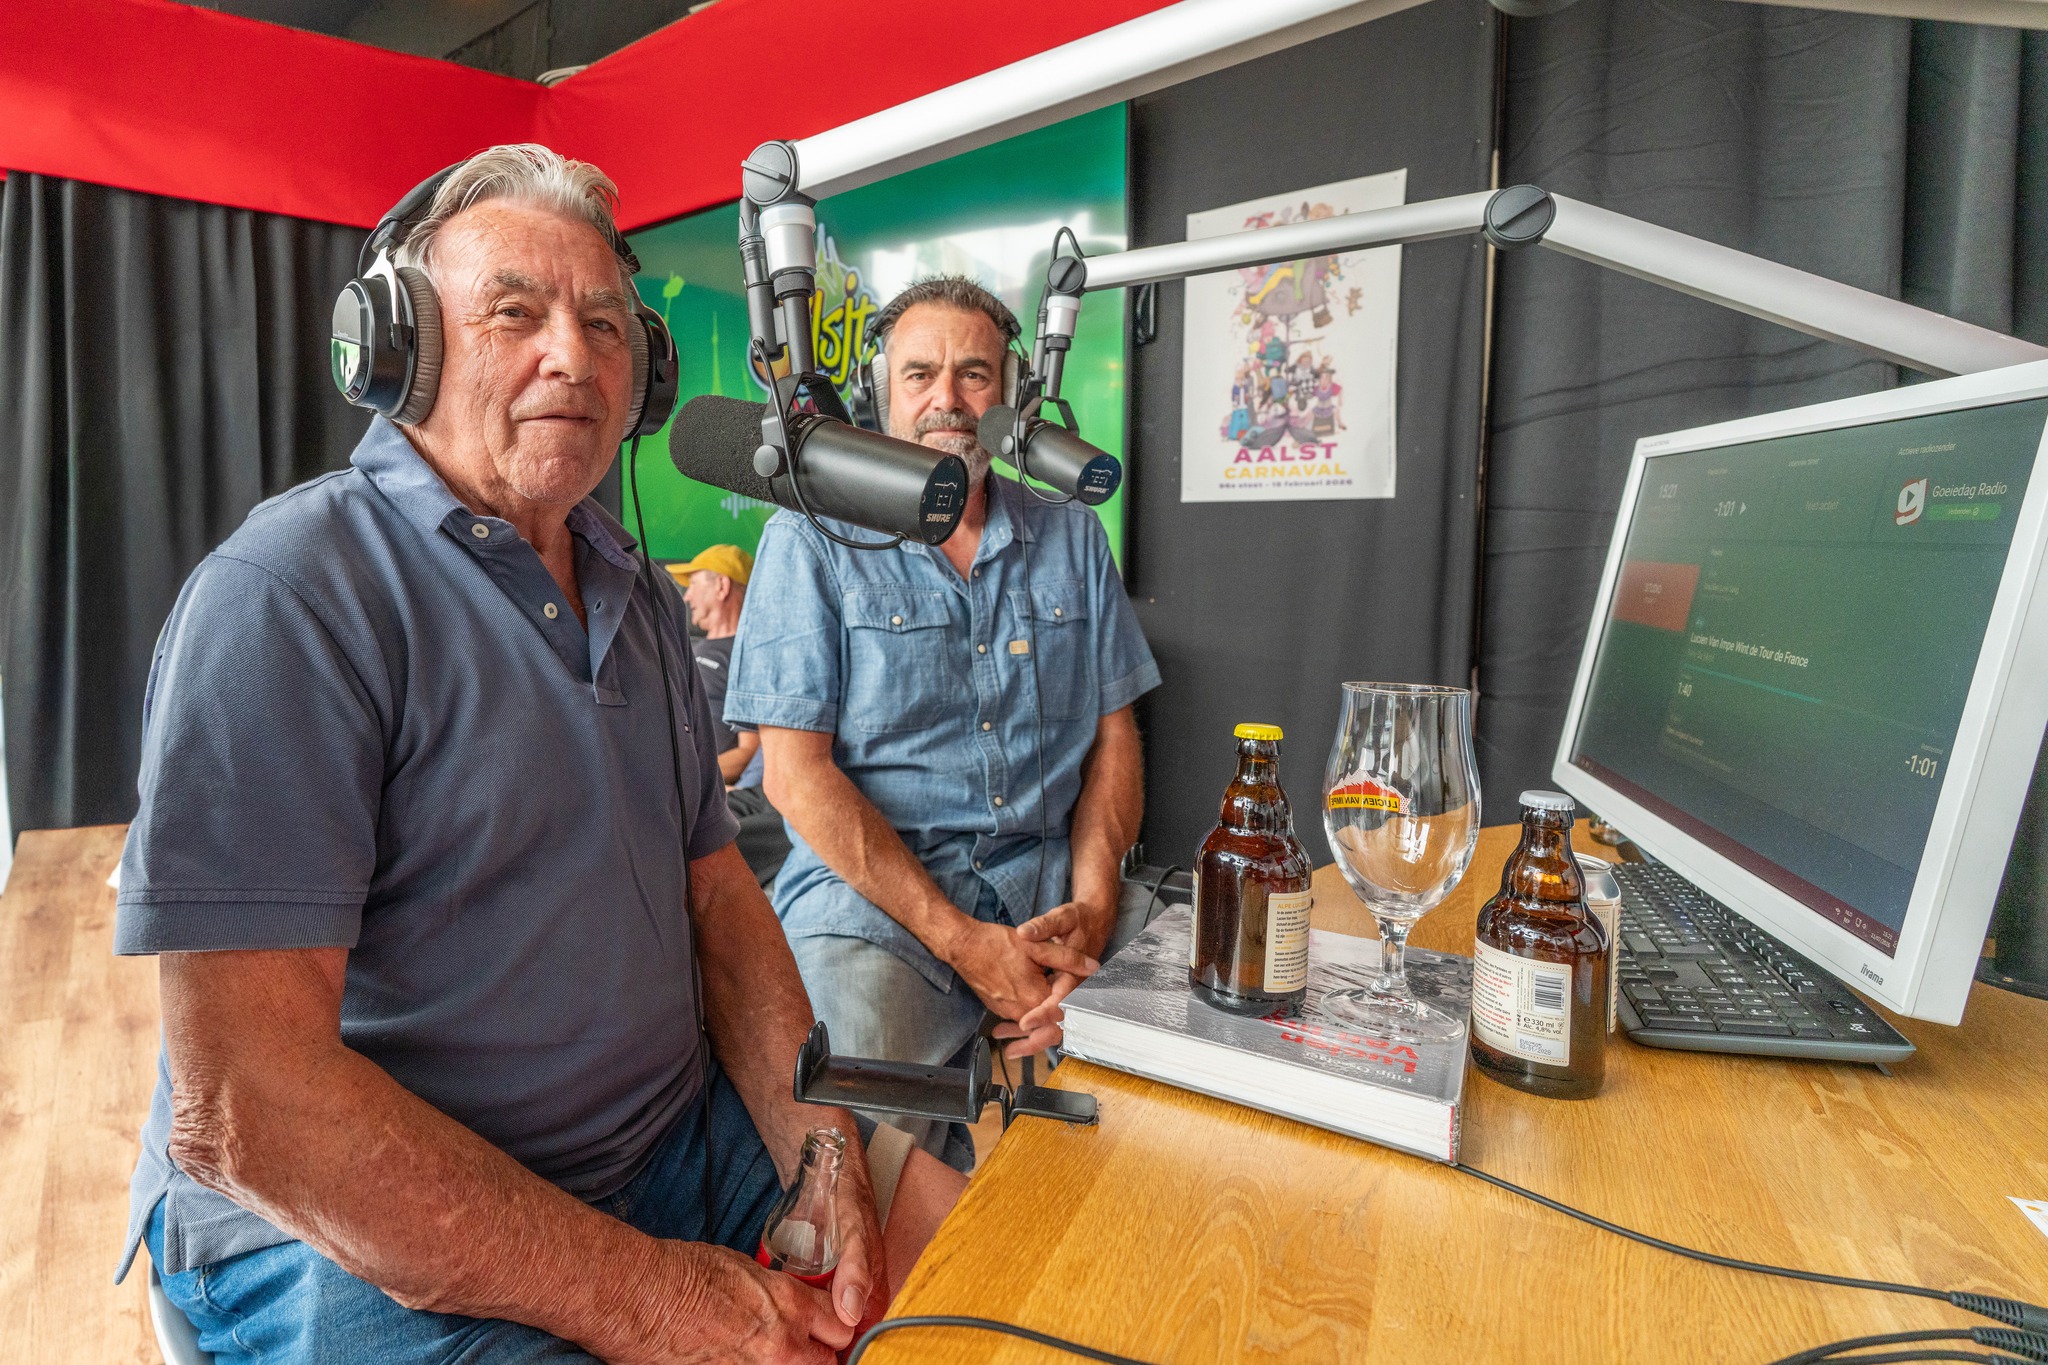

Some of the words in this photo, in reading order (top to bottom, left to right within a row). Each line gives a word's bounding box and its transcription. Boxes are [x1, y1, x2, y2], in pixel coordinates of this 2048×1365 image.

[1233, 443, 1338, 464] AALST
[1224, 463, 1348, 480] CARNAVAL
[1932, 484, 1977, 499] Goeiedag
[1977, 481, 2008, 496] Radio
[926, 512, 951, 523] SHURE
[1690, 632, 1708, 645] Lucien
[1709, 635, 1720, 648] Van
[1720, 638, 1735, 652] Impe
[1735, 641, 1750, 655] Wint
[1750, 644, 1758, 656] de
[1759, 645, 1774, 660] Tour
[1774, 650, 1783, 662] de
[1784, 651, 1809, 668] France
[1904, 754, 1937, 779] -1:01
[1860, 963, 1884, 986] iiyama
[1531, 1019, 1544, 1027] 330
[1280, 1031, 1417, 1074] Lucien
[1336, 1031, 1419, 1061] Van
